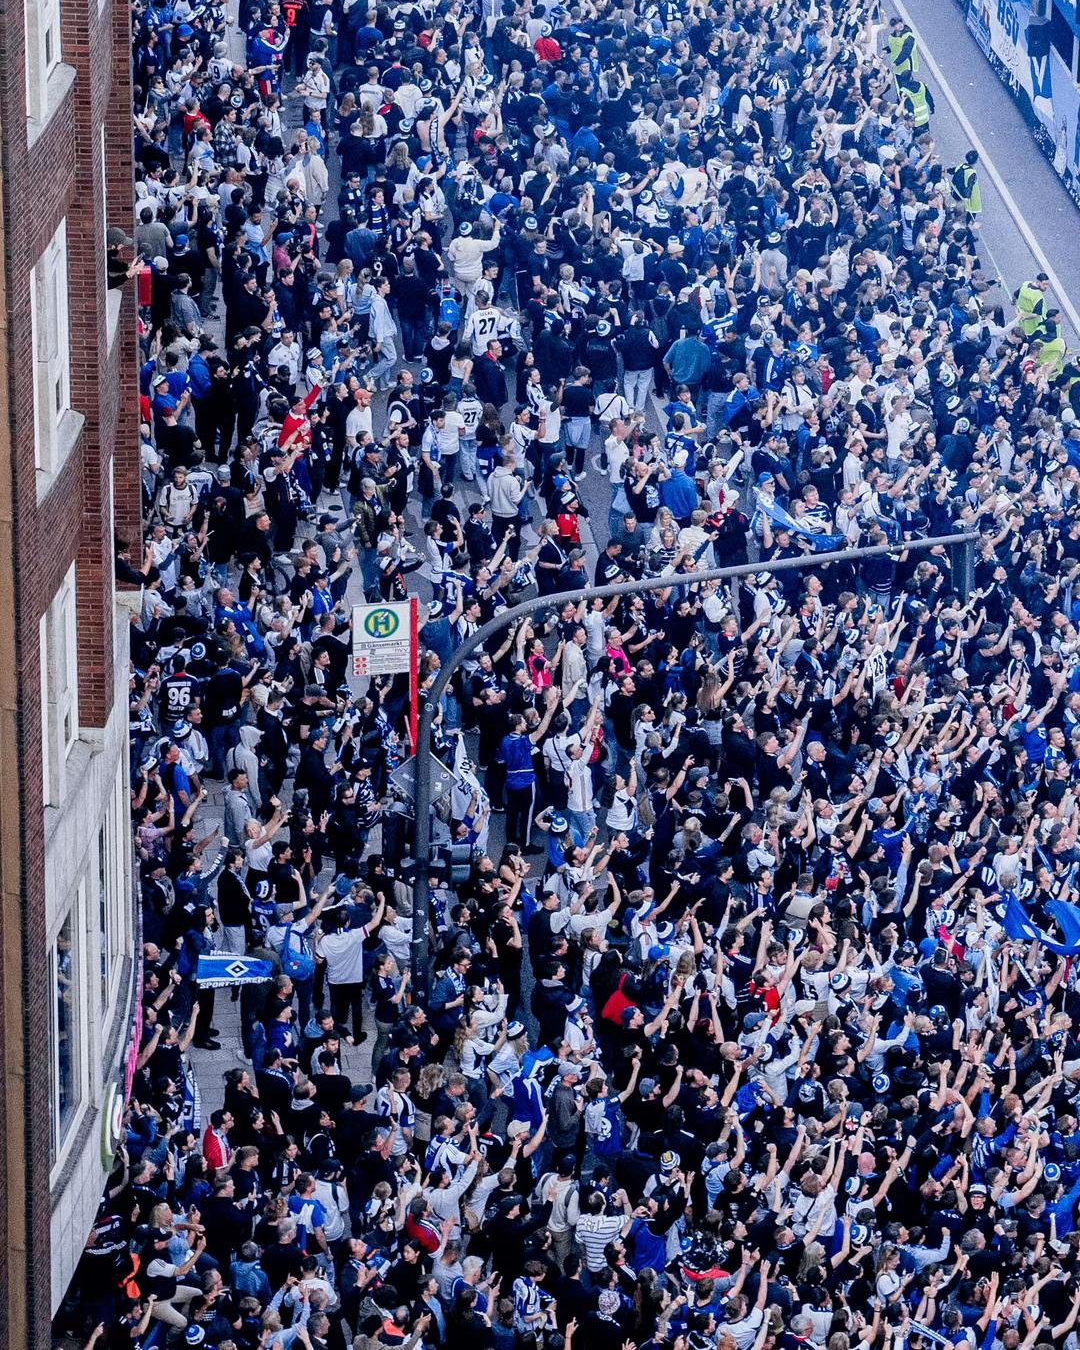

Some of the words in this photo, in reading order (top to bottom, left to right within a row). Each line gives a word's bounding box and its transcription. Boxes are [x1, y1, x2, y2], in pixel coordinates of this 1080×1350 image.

[287, 8, 296, 23] 9
[213, 65, 221, 80] 9
[479, 317, 496, 336] 27
[463, 411, 477, 424] 27
[168, 687, 191, 706] 96
